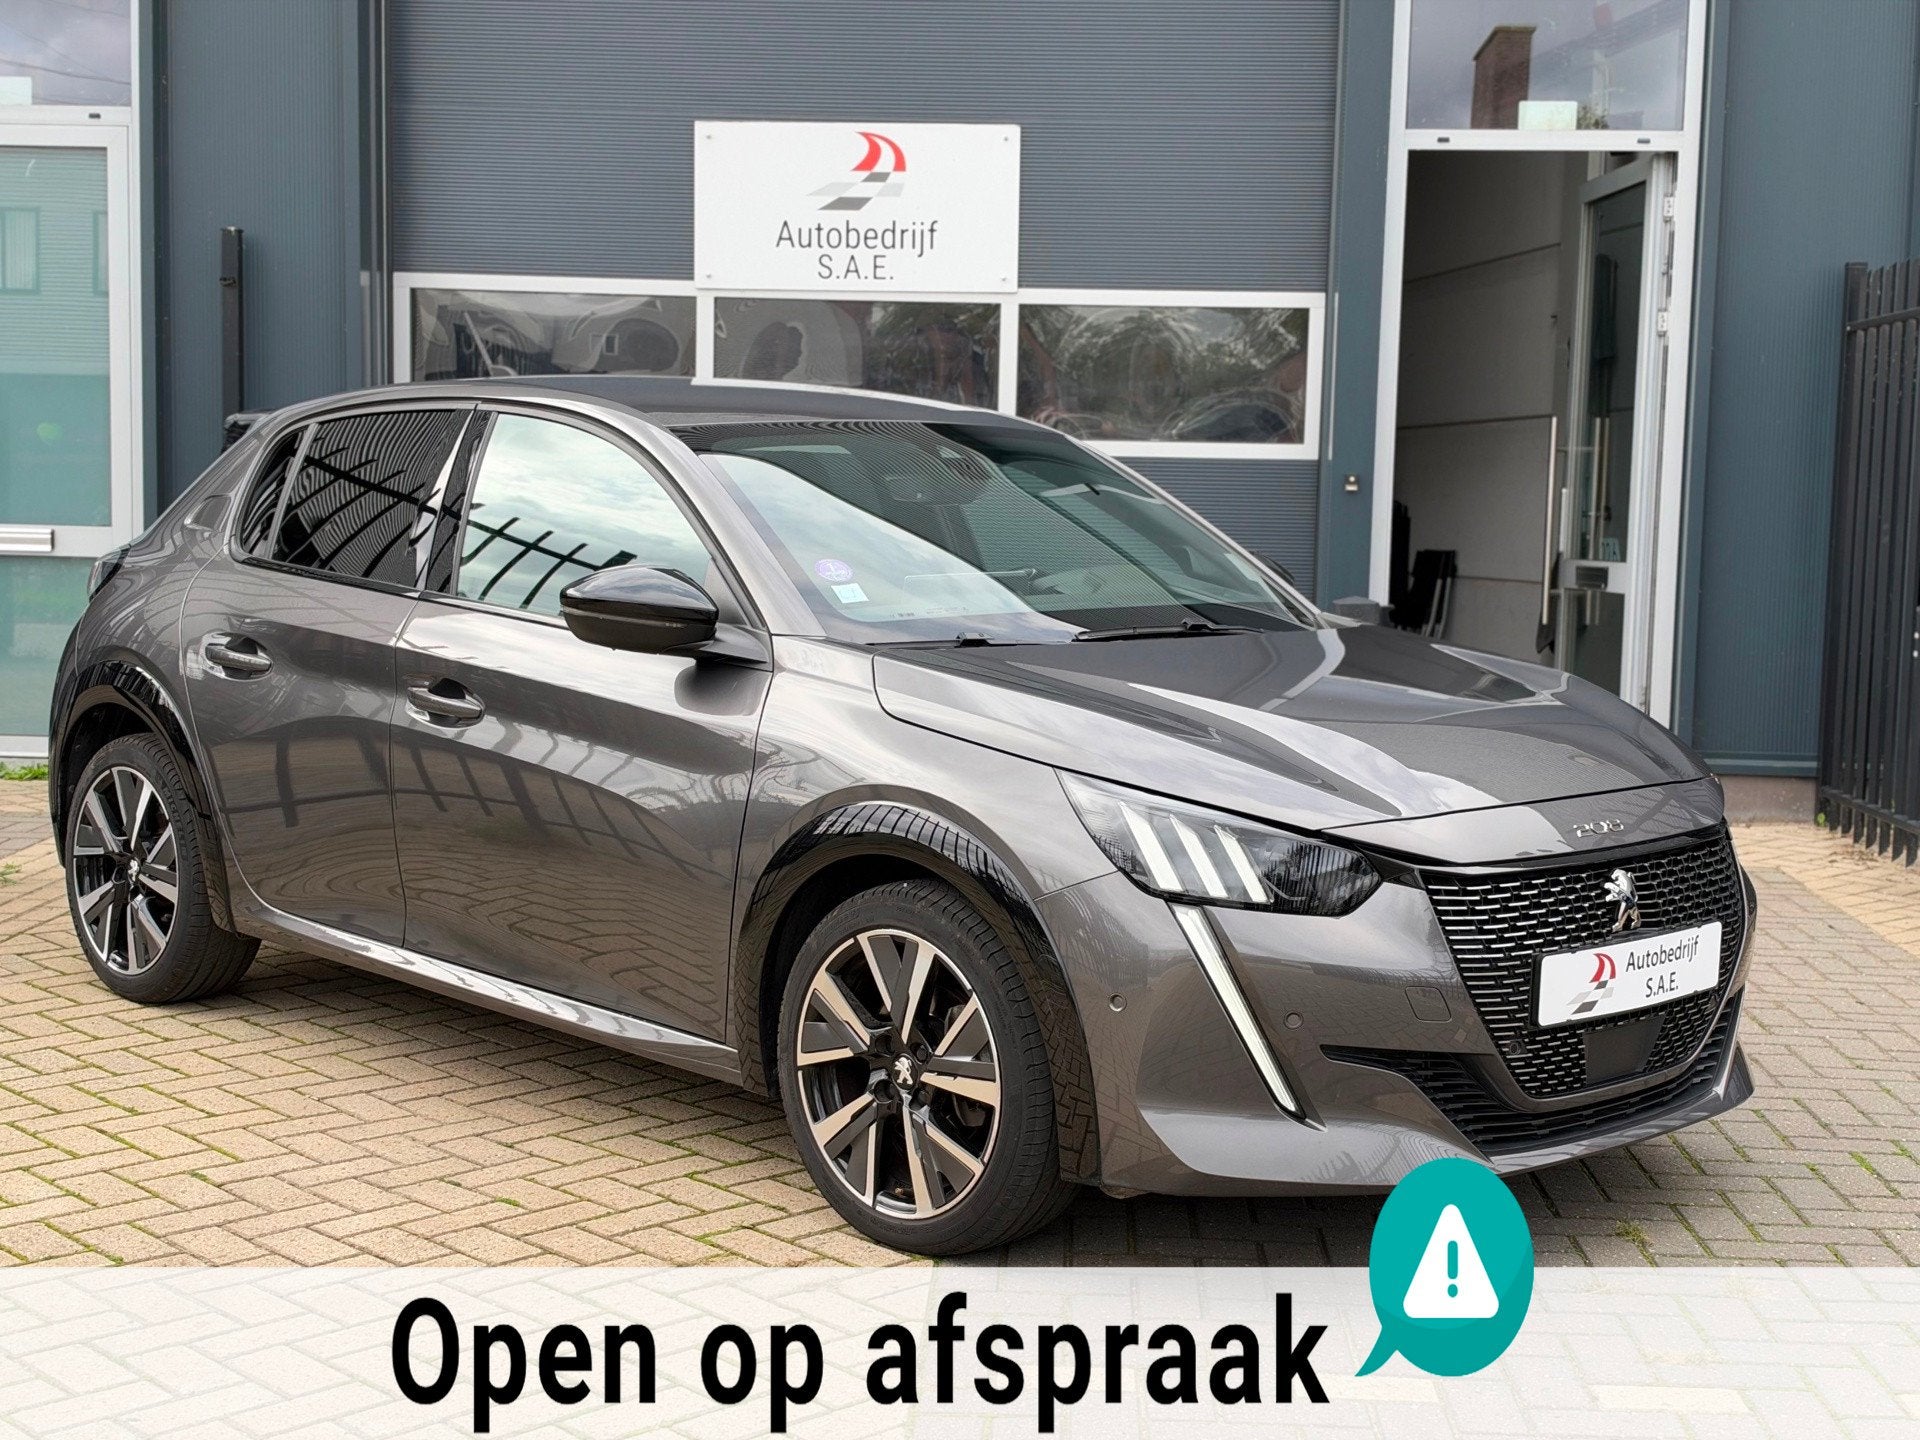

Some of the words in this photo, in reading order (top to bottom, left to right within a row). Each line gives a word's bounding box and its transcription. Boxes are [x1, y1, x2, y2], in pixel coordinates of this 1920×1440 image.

[776, 220, 938, 257] Autobedrijf
[818, 254, 894, 280] S.A.E.
[1573, 819, 1624, 838] 208
[1625, 934, 1699, 972] Autobedrijf
[1645, 971, 1679, 998] S.A.E.
